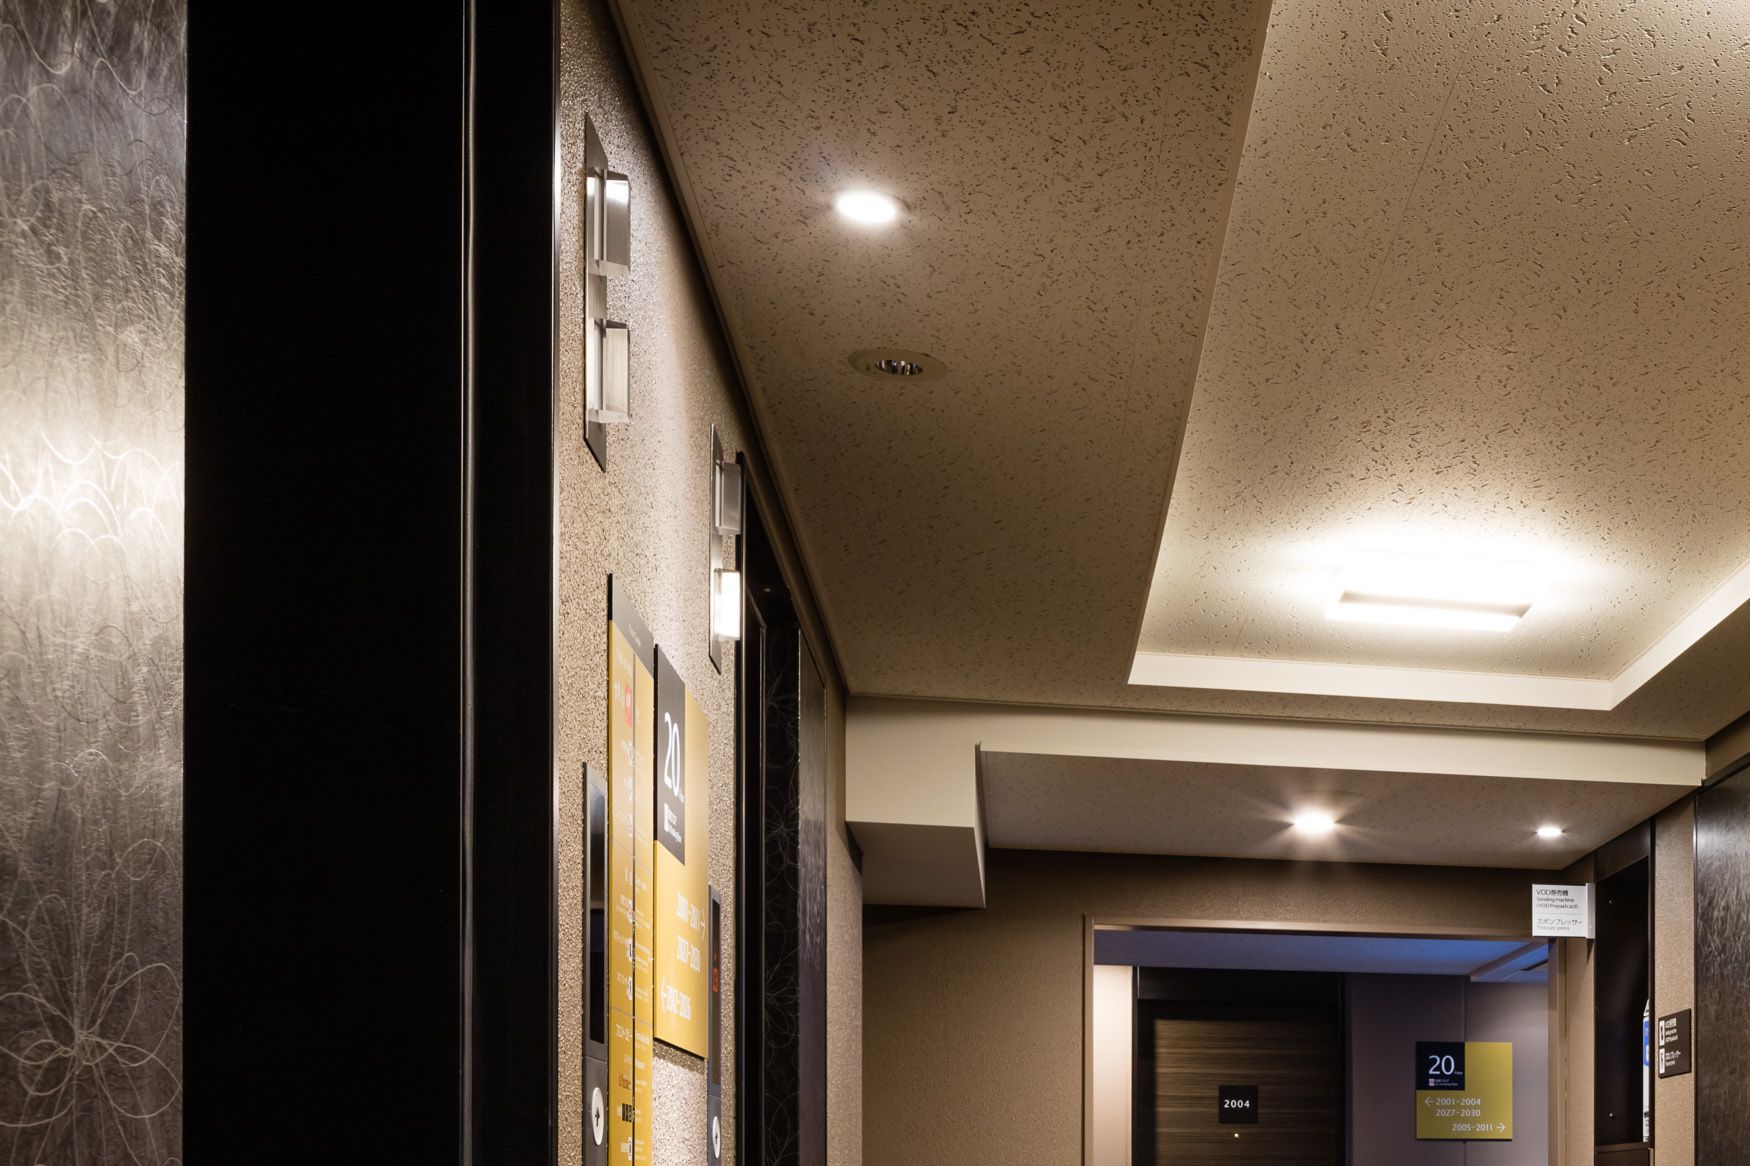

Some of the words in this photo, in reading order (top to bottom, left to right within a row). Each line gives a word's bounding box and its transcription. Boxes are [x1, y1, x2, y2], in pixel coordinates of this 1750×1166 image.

[664, 711, 680, 797] 20
[1429, 1055, 1455, 1075] 20
[1224, 1099, 1250, 1108] 2004
[1436, 1097, 1481, 1106] 2001-2004
[1436, 1109, 1481, 1117] 2027-2030
[1452, 1123, 1493, 1132] 2005-2011
